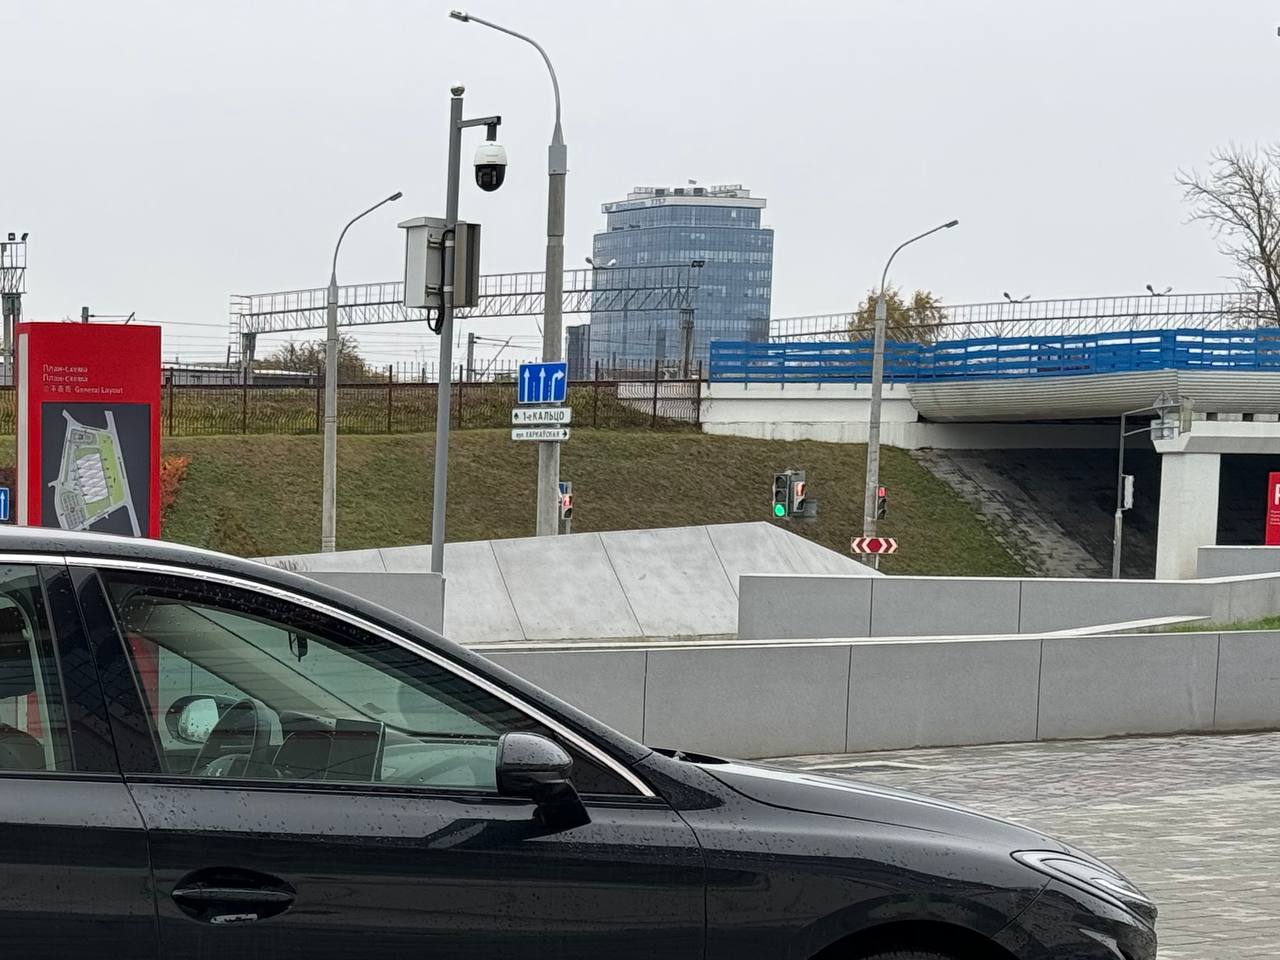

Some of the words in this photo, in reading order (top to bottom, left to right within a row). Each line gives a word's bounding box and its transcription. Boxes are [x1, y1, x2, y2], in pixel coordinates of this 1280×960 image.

[74, 386, 100, 394] General
[100, 387, 124, 396] Layout
[533, 411, 565, 421] КАЛЬЦО
